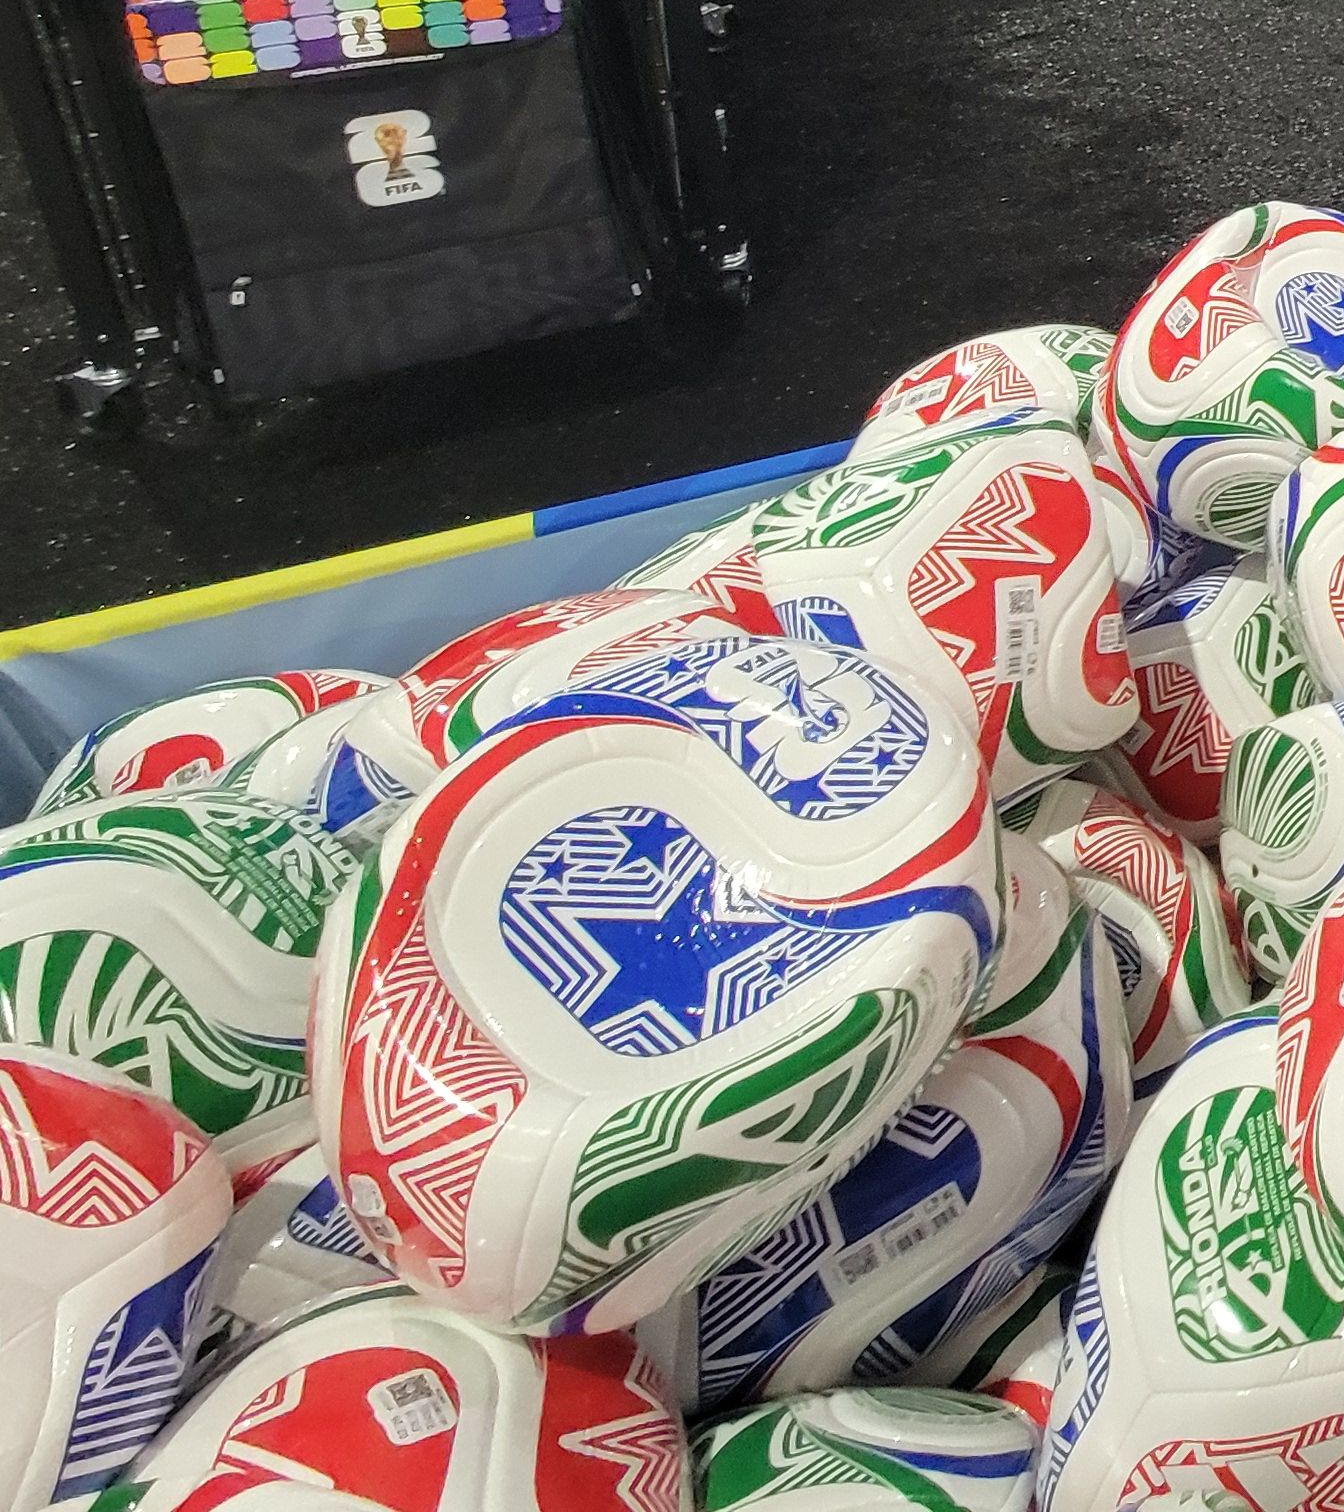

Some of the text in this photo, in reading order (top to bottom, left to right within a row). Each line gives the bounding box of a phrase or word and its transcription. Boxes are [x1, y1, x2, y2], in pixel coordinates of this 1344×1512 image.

[384, 181, 423, 198] FIFA
[734, 646, 791, 674] FIFA
[1266, 1109, 1279, 1149] MATCH
[1261, 1155, 1275, 1182] BALL
[1266, 1182, 1282, 1217] MATCH
